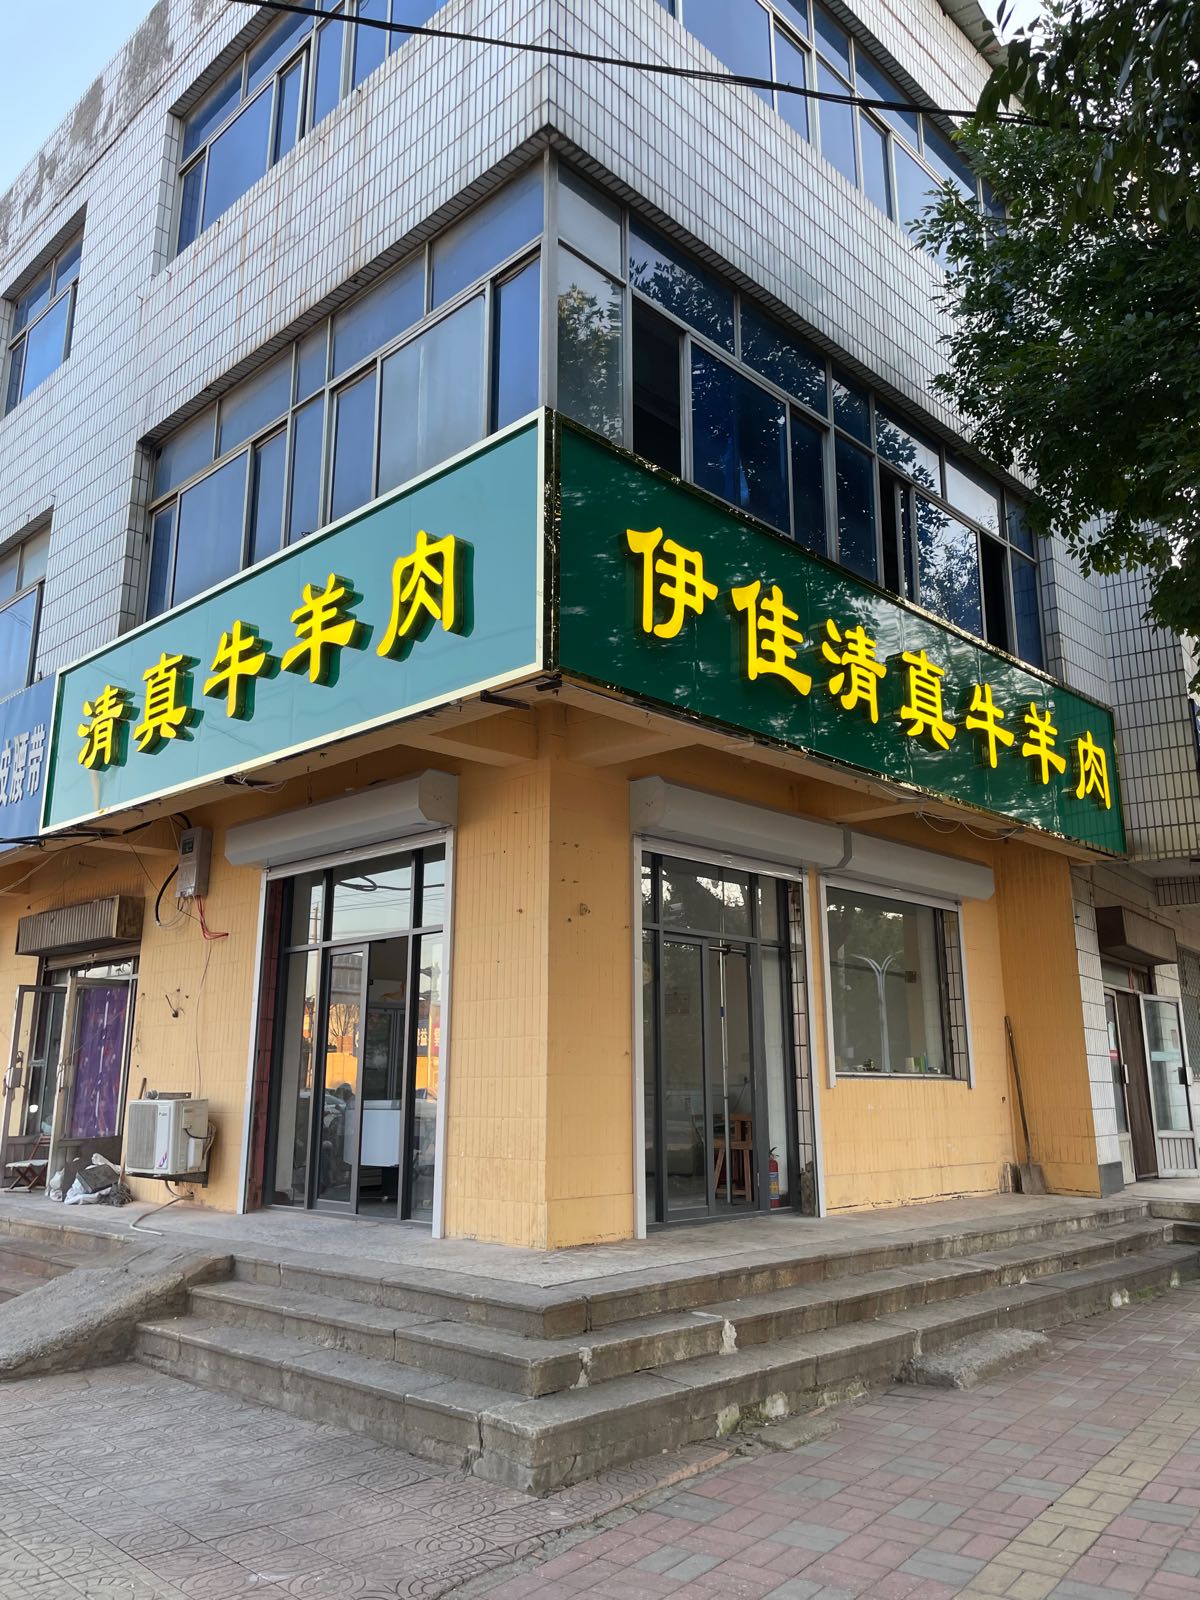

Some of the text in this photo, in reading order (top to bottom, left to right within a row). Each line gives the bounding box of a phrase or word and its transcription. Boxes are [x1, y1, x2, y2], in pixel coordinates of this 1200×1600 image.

[77, 530, 456, 769] 清真牛羊肉
[626, 527, 1111, 810] 伊佳清真牛羊肉
